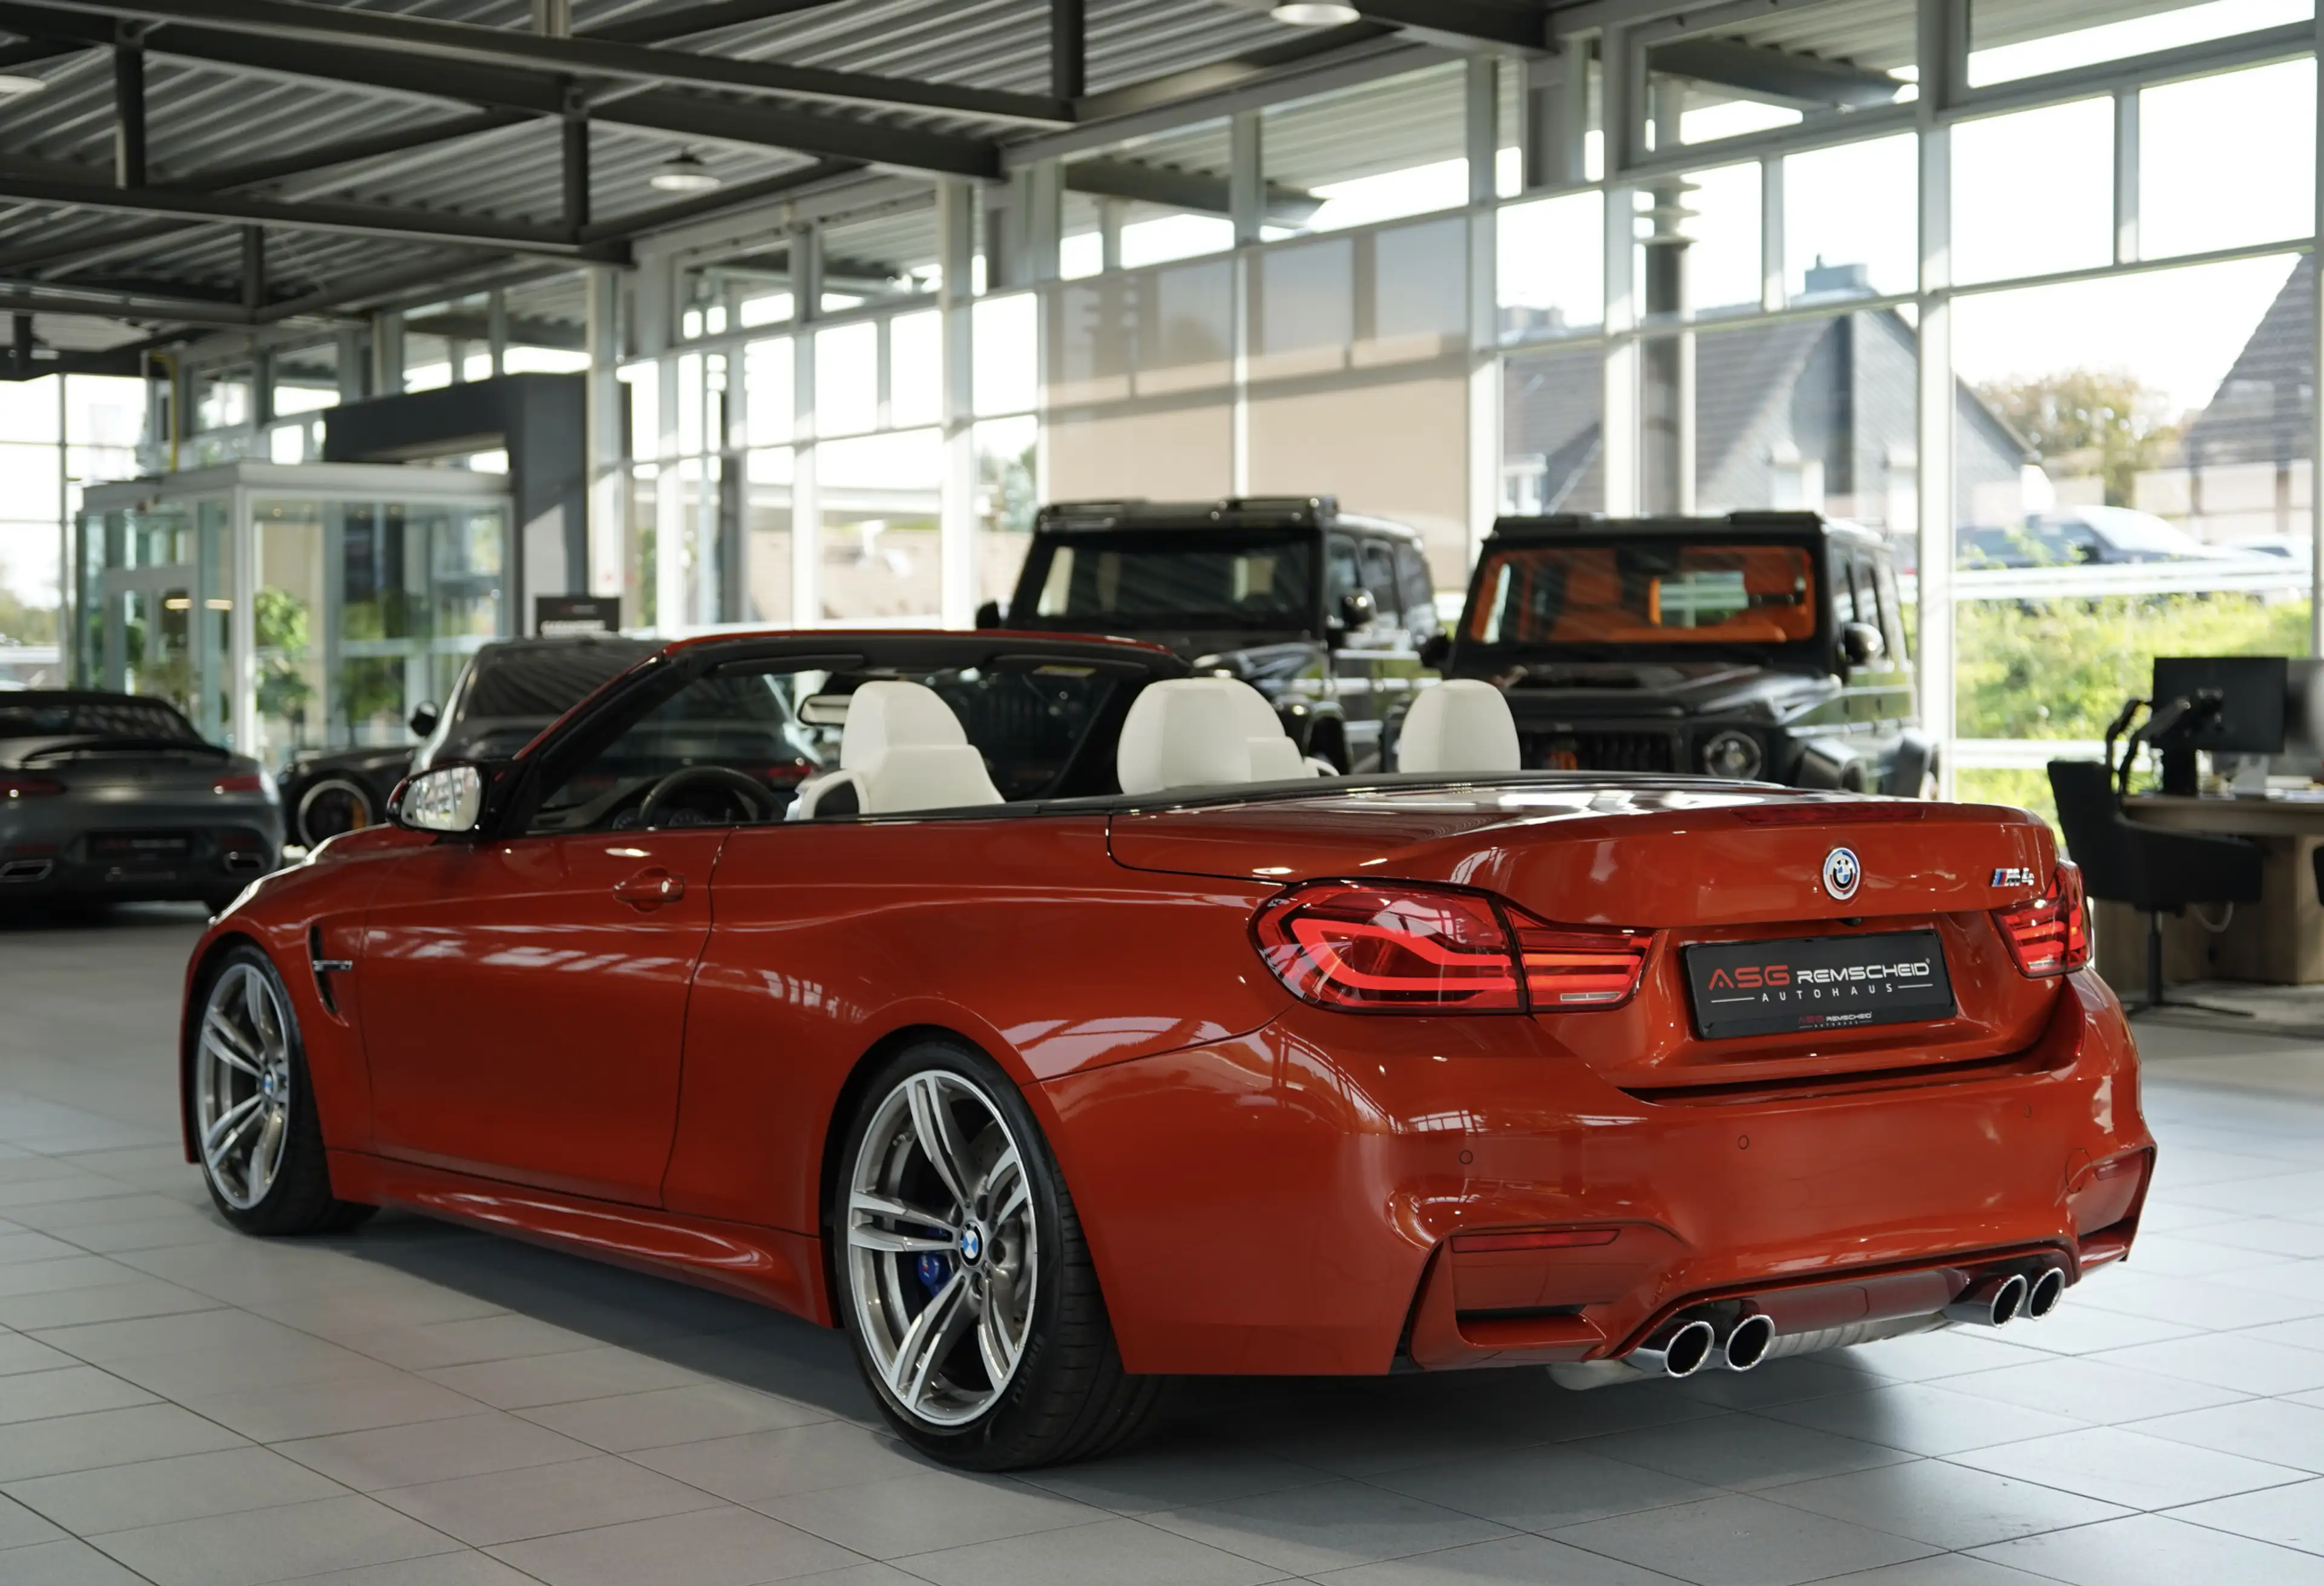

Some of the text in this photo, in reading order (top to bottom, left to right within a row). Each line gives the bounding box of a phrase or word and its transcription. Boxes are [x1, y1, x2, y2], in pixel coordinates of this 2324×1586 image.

[1992, 867, 2034, 887] M4
[1709, 965, 1790, 990] ASG
[1762, 983, 1892, 1002] AUTOHAUS
